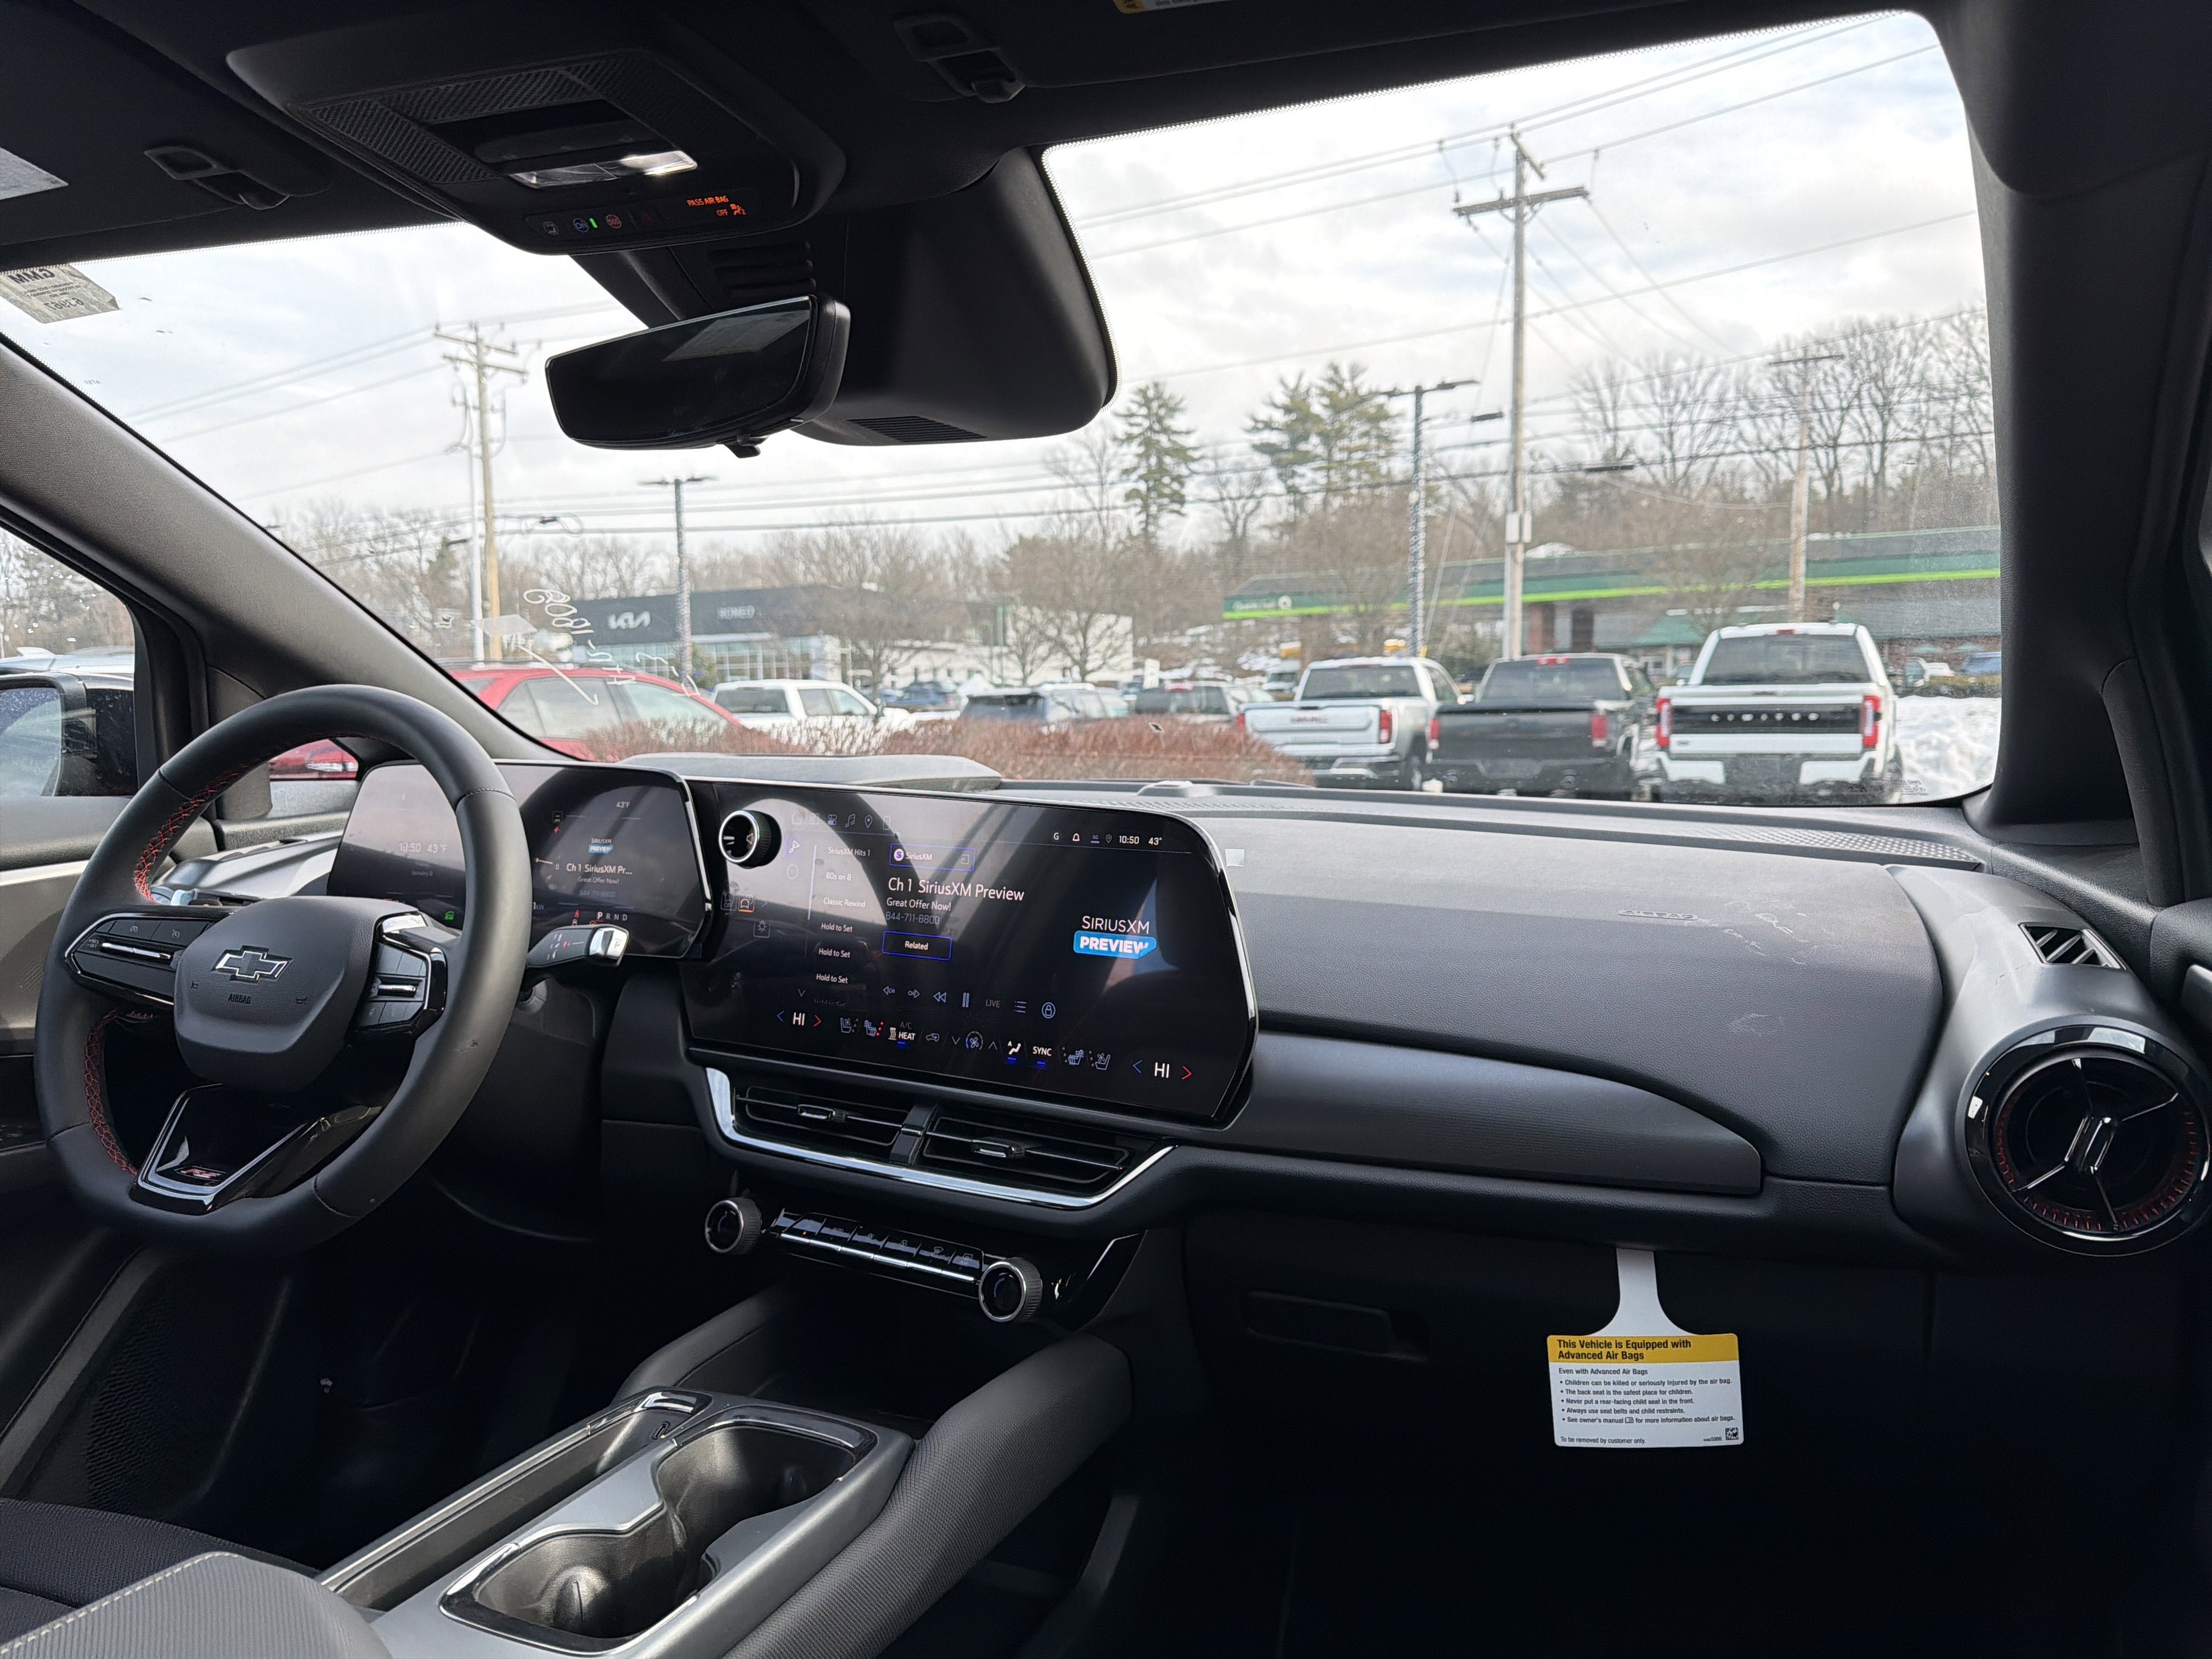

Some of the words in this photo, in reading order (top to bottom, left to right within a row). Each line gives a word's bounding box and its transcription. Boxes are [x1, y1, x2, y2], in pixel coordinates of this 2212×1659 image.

[687, 198, 704, 206] PASS
[1053, 832, 1059, 840] G
[1119, 835, 1139, 844] 10:50
[1148, 837, 1163, 845] 43°
[399, 842, 421, 853] 10:50
[828, 847, 853, 855] SiriusXM
[854, 848, 866, 856] Hits
[905, 851, 933, 861] SiriusXM
[566, 863, 576, 872] Ch
[584, 864, 616, 874] SiriusXM
[618, 866, 632, 875] Pr...
[888, 877, 904, 891] Ch
[908, 878, 912, 892] 1
[918, 879, 972, 897] SiriusXM
[975, 884, 1025, 901] Preview
[823, 897, 843, 906] Classic
[844, 899, 866, 908] Rewind
[887, 897, 907, 907] Great
[909, 899, 929, 910] Offer
[931, 899, 951, 911] Now!
[597, 911, 603, 920] P
[885, 911, 940, 925] 844-711-8800
[821, 922, 835, 931] Hold
[843, 924, 853, 933] Set
[1081, 915, 1150, 934] SIRIUSXM
[905, 940, 928, 950] Related
[819, 947, 832, 956] Hold
[840, 950, 850, 958] Set
[816, 973, 830, 981] Hold
[838, 975, 848, 984] Set
[228, 993, 251, 1005] AIRBAG
[985, 998, 1001, 1008] LIVE
[792, 1012, 805, 1026] HI
[900, 1020, 912, 1030] A/C
[898, 1031, 916, 1041] HEAT
[1032, 1045, 1052, 1057] SYNC
[1154, 1062, 1170, 1079] HI
[1557, 1339, 1577, 1348] This
[1579, 1339, 1612, 1349] Vehicle
[1615, 1340, 1623, 1349] is
[1625, 1339, 1668, 1351] Equipped
[1671, 1339, 1691, 1348] with
[1558, 1350, 1603, 1359] Advanced
[1605, 1351, 1619, 1359] Air
[1621, 1351, 1644, 1362] Bags
